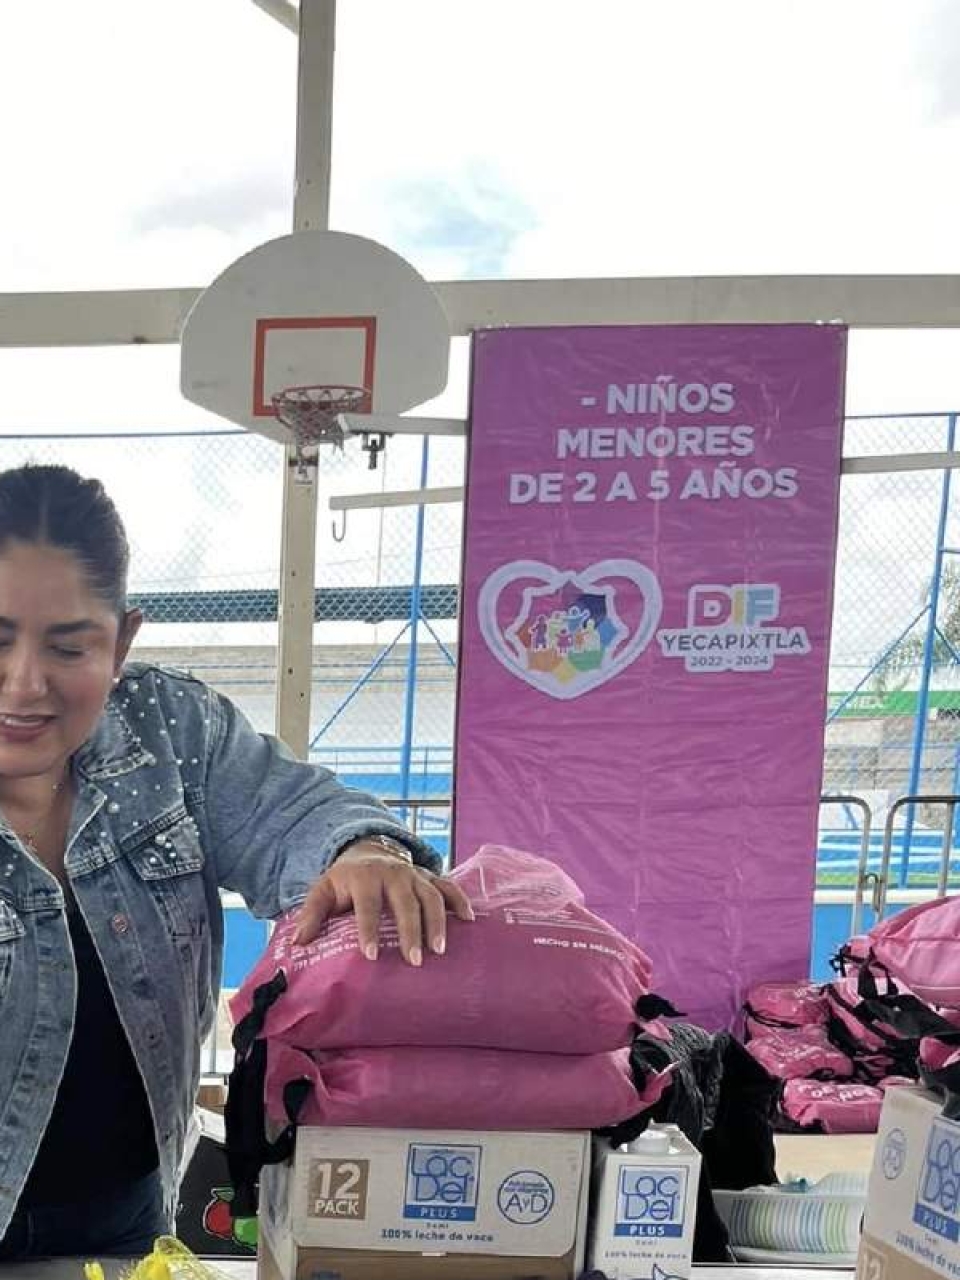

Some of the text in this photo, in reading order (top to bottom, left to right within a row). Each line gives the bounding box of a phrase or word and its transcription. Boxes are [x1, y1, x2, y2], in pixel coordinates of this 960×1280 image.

[607, 375, 735, 414] NIÑOS
[557, 425, 755, 459] MENORES
[509, 461, 799, 503] DE 2 A 5 AÑOS
[693, 589, 774, 627] DIF
[663, 633, 804, 651] YECAPIXTLA
[691, 656, 723, 666] 2022
[736, 655, 769, 665] 2024
[534, 937, 570, 948] HECHO
[317, 1162, 361, 1200] 12
[314, 1199, 360, 1216] PACK
[420, 1207, 458, 1218] PLUS
[381, 1229, 494, 1243] 100% leche de vaca
[629, 1225, 665, 1236] PLUS
